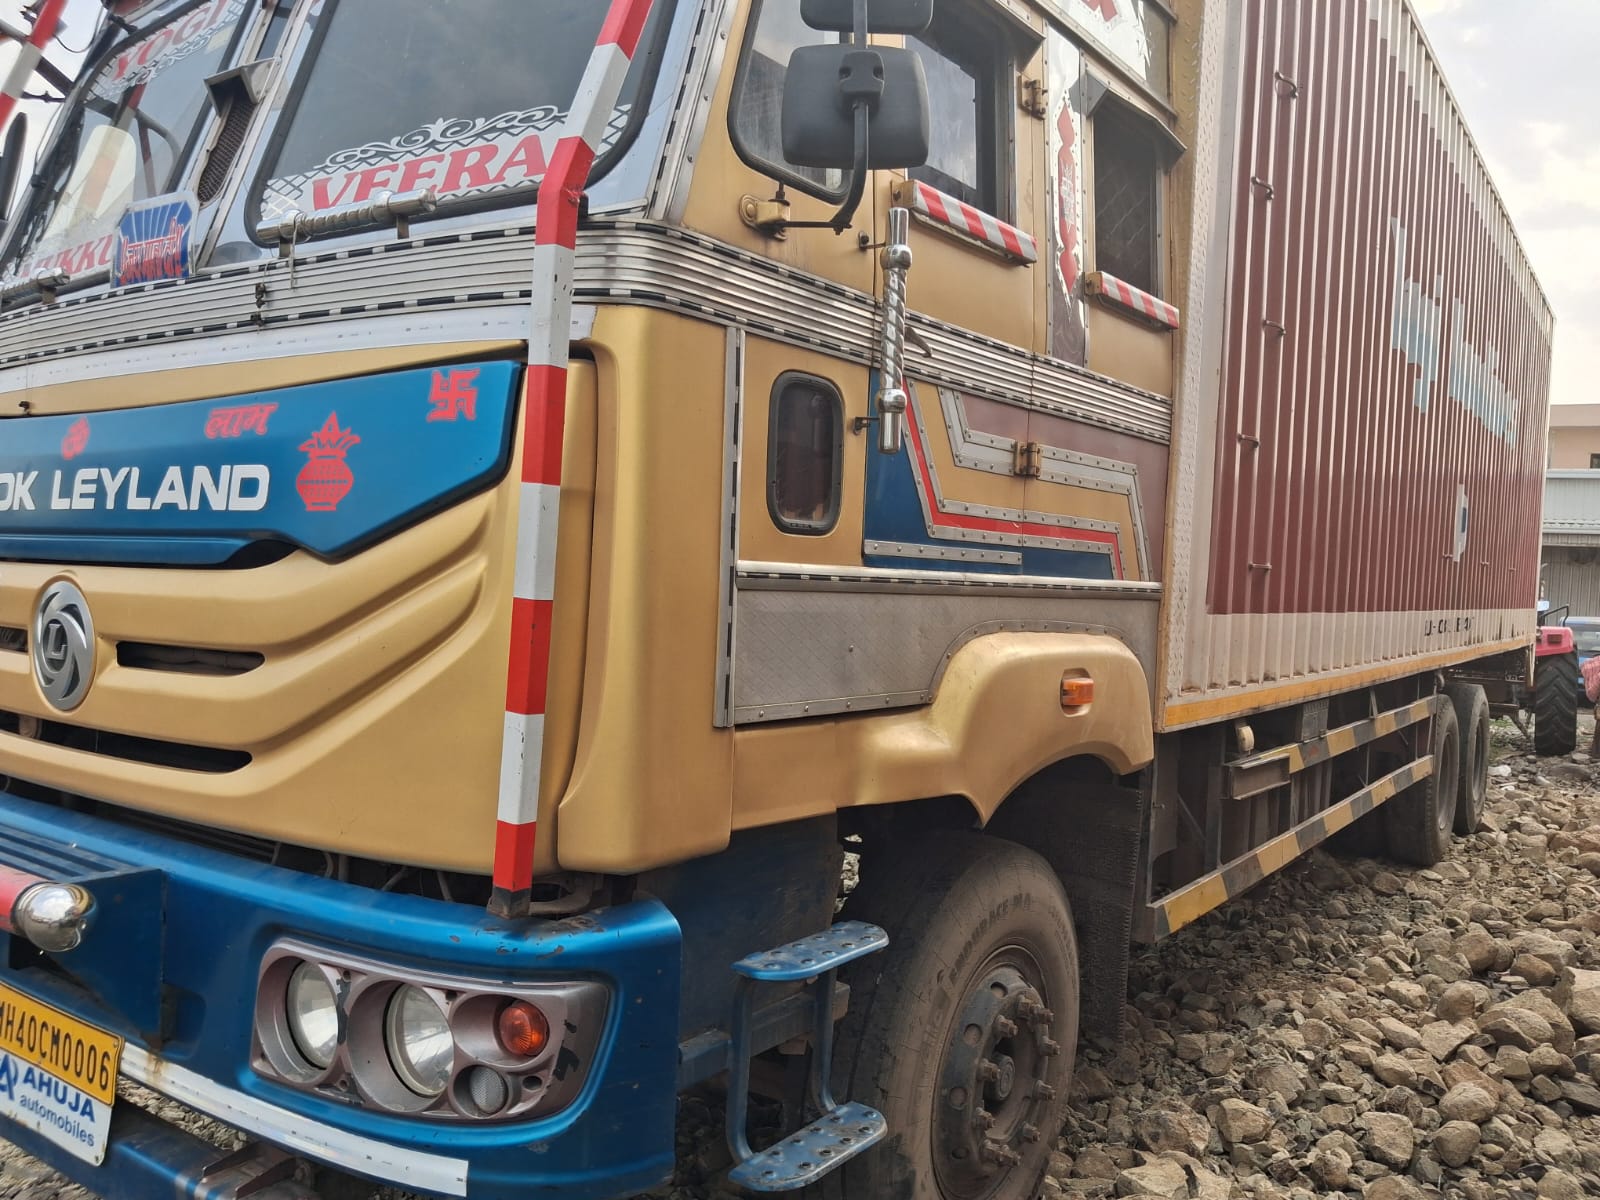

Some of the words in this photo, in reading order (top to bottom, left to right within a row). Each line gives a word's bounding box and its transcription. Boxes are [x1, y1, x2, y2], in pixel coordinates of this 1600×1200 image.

[51, 464, 270, 511] LEYLAND
[20, 1092, 96, 1147] automobiles
[23, 1066, 96, 1123] AHUJA
